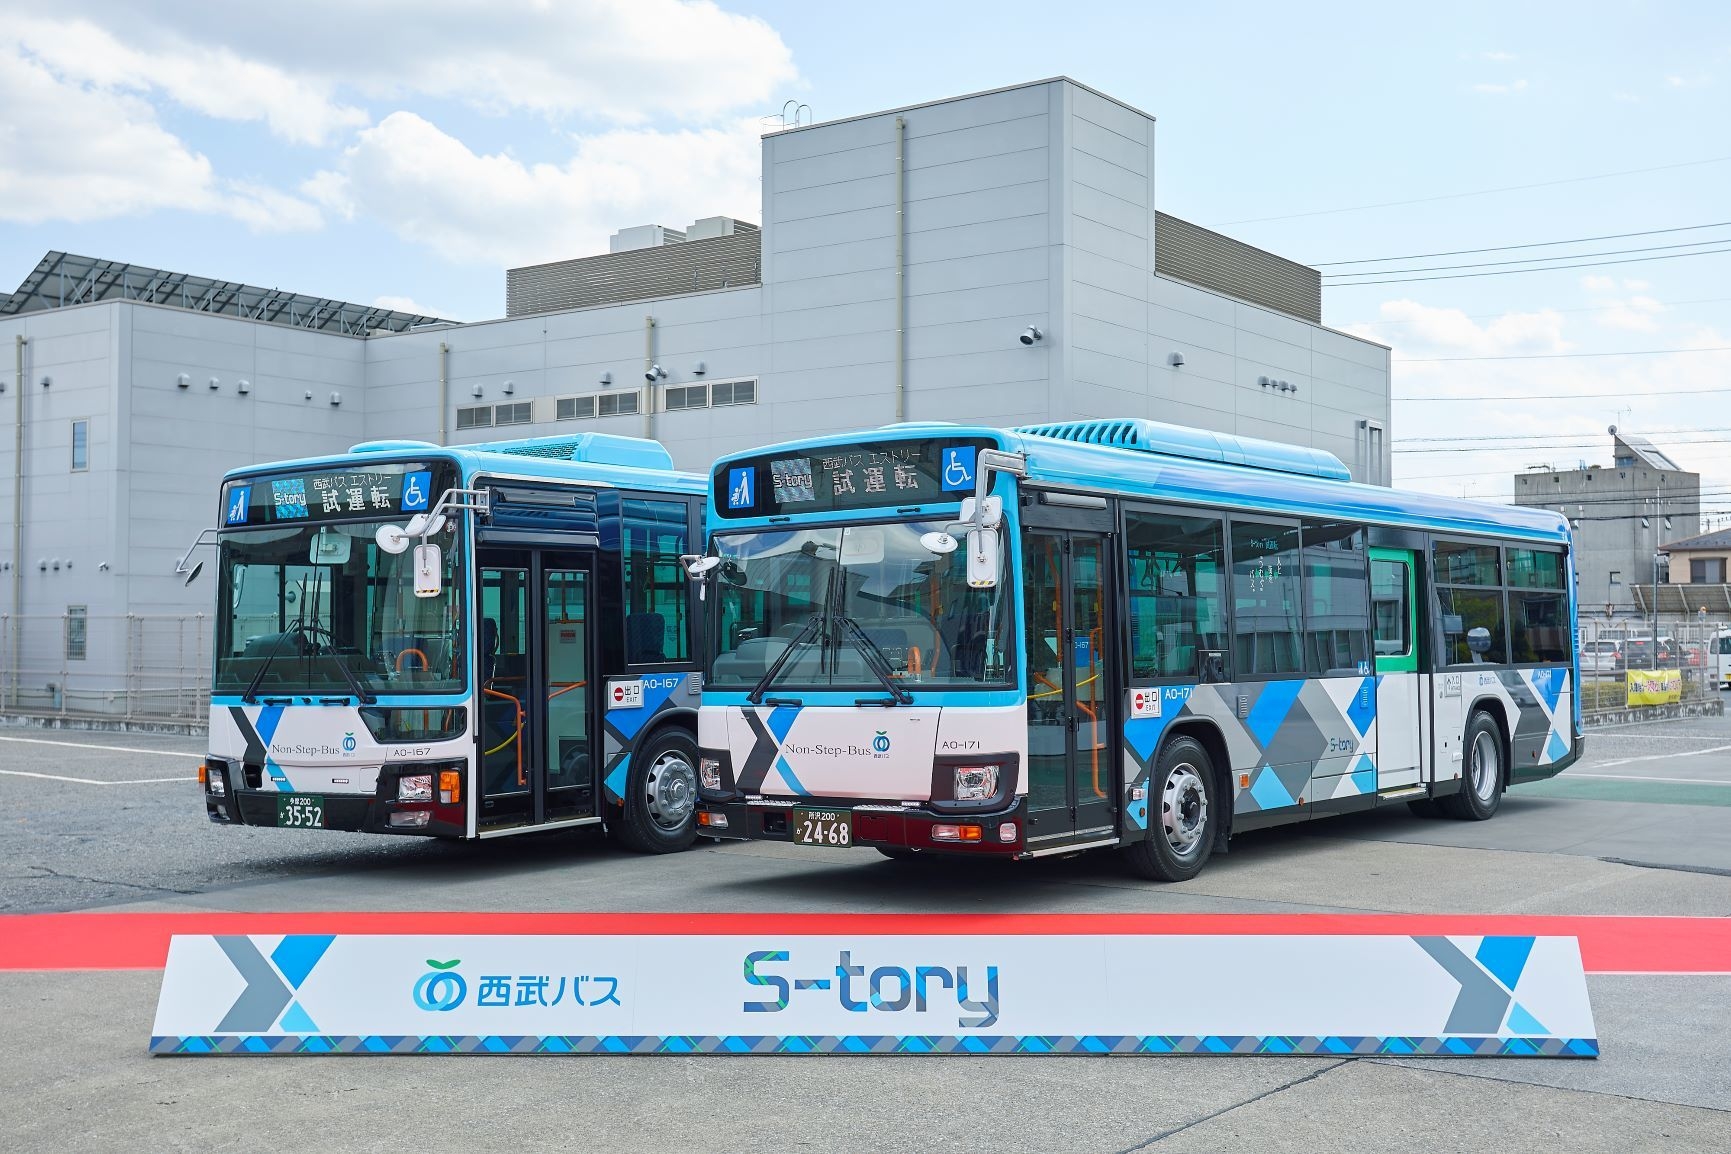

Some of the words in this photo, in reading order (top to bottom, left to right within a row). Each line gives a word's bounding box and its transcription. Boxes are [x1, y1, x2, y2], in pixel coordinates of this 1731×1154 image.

[822, 454, 865, 470] 西武バス
[868, 449, 921, 465] エストリー
[313, 476, 347, 490] 西武バス
[350, 472, 392, 486] エストリー
[832, 464, 919, 496] 試運転
[321, 485, 391, 513] 試運転
[624, 685, 639, 695] 出口
[643, 678, 678, 688] AO-167
[1145, 691, 1157, 702] 出口
[1165, 688, 1193, 699] AO-171
[271, 744, 340, 756] Non-Step-Bus
[393, 747, 431, 757] AO-167
[785, 743, 872, 757] Non-Step-Bus
[942, 740, 981, 750] AO-171
[1330, 737, 1354, 754] S-tory
[477, 975, 621, 1008] 西武バス
[743, 950, 1000, 1028] S-tory
